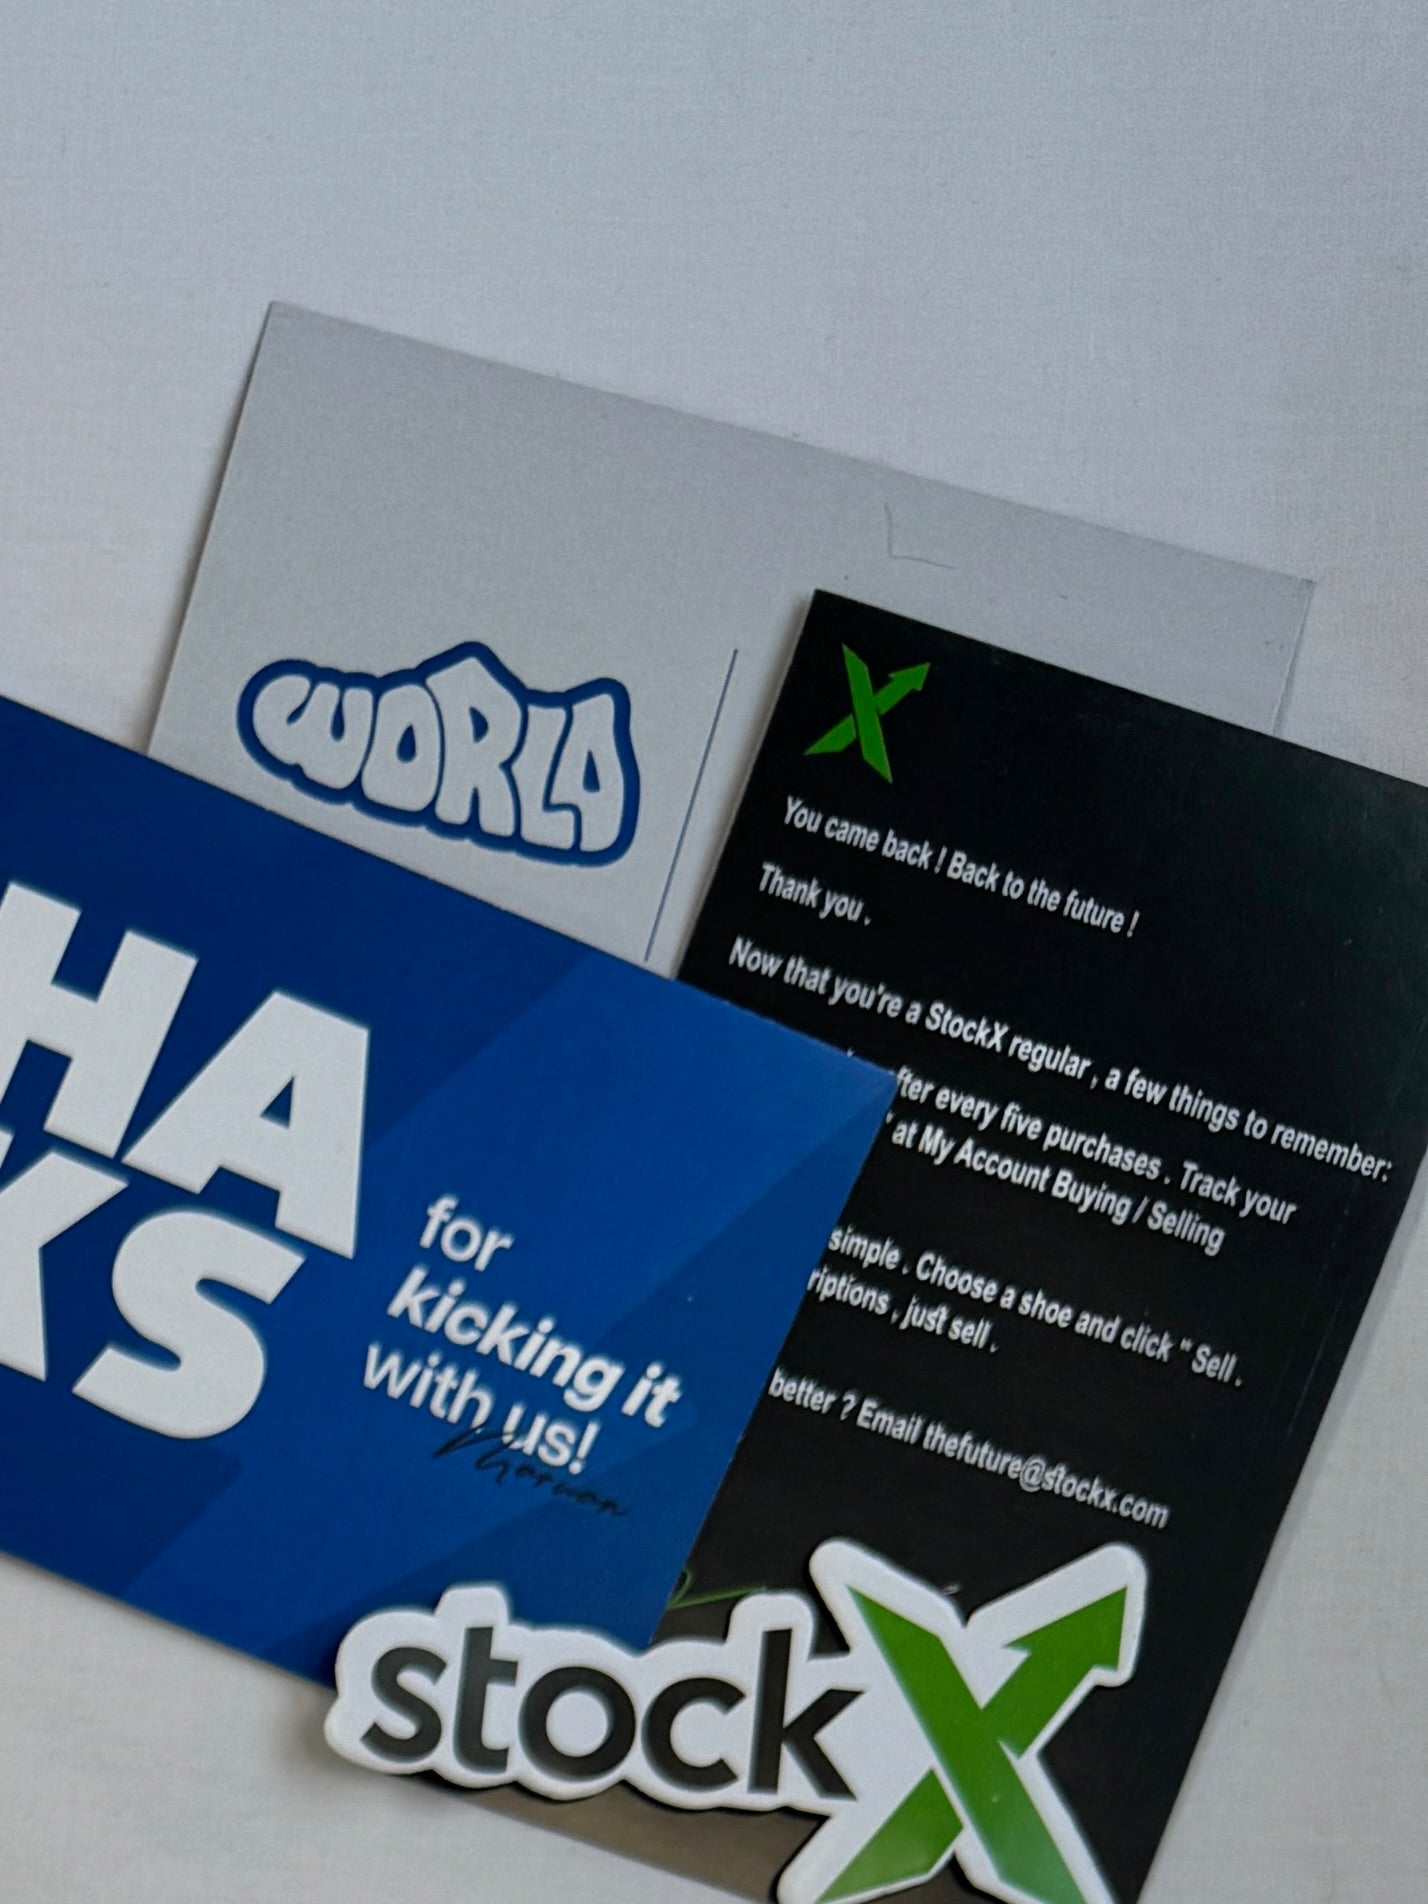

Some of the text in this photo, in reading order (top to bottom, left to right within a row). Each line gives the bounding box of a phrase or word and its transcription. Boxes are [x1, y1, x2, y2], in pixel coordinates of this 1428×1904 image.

[758, 862, 821, 908] Thank
[784, 795, 820, 832] You
[825, 815, 880, 852] came
[881, 829, 933, 870] back
[947, 850, 999, 892] Back
[1002, 870, 1025, 900] to
[1027, 875, 1061, 912] the
[1062, 888, 1125, 934] future
[728, 935, 782, 977] Now
[783, 948, 830, 995] that
[828, 975, 902, 1018] you're
[905, 1000, 921, 1025] a
[925, 1000, 1010, 1052] StockX
[1105, 1067, 1122, 1091] a
[1124, 1066, 1168, 1105] few
[1168, 1083, 1240, 1133] things
[1243, 1109, 1268, 1140] to
[1270, 1123, 1393, 1183] remember:
[891, 1118, 919, 1149] at
[917, 1121, 956, 1166] My
[953, 1136, 1052, 1193] Account
[1051, 1168, 1133, 1226] Buying
[1147, 1200, 1226, 1257] Selling
[896, 1064, 934, 1104] fter
[935, 1085, 1000, 1132] every
[1000, 1101, 1042, 1141] five
[1179, 1160, 1241, 1207] Track
[1238, 1188, 1298, 1226] your
[420, 1193, 514, 1271] for
[806, 1264, 892, 1316] riptions
[898, 1293, 951, 1336] just
[387, 1264, 682, 1428] kicking it
[915, 1248, 999, 1303] Choose
[999, 1285, 1016, 1310] a
[1018, 1288, 1074, 1328] shoe
[1074, 1309, 1123, 1344] and
[1120, 1321, 1174, 1363] click
[363, 1343, 495, 1435] with
[502, 1403, 601, 1475] us!
[768, 1366, 836, 1415] better
[855, 1397, 925, 1445] Email
[922, 1419, 1171, 1530] thefuture@stockx.com
